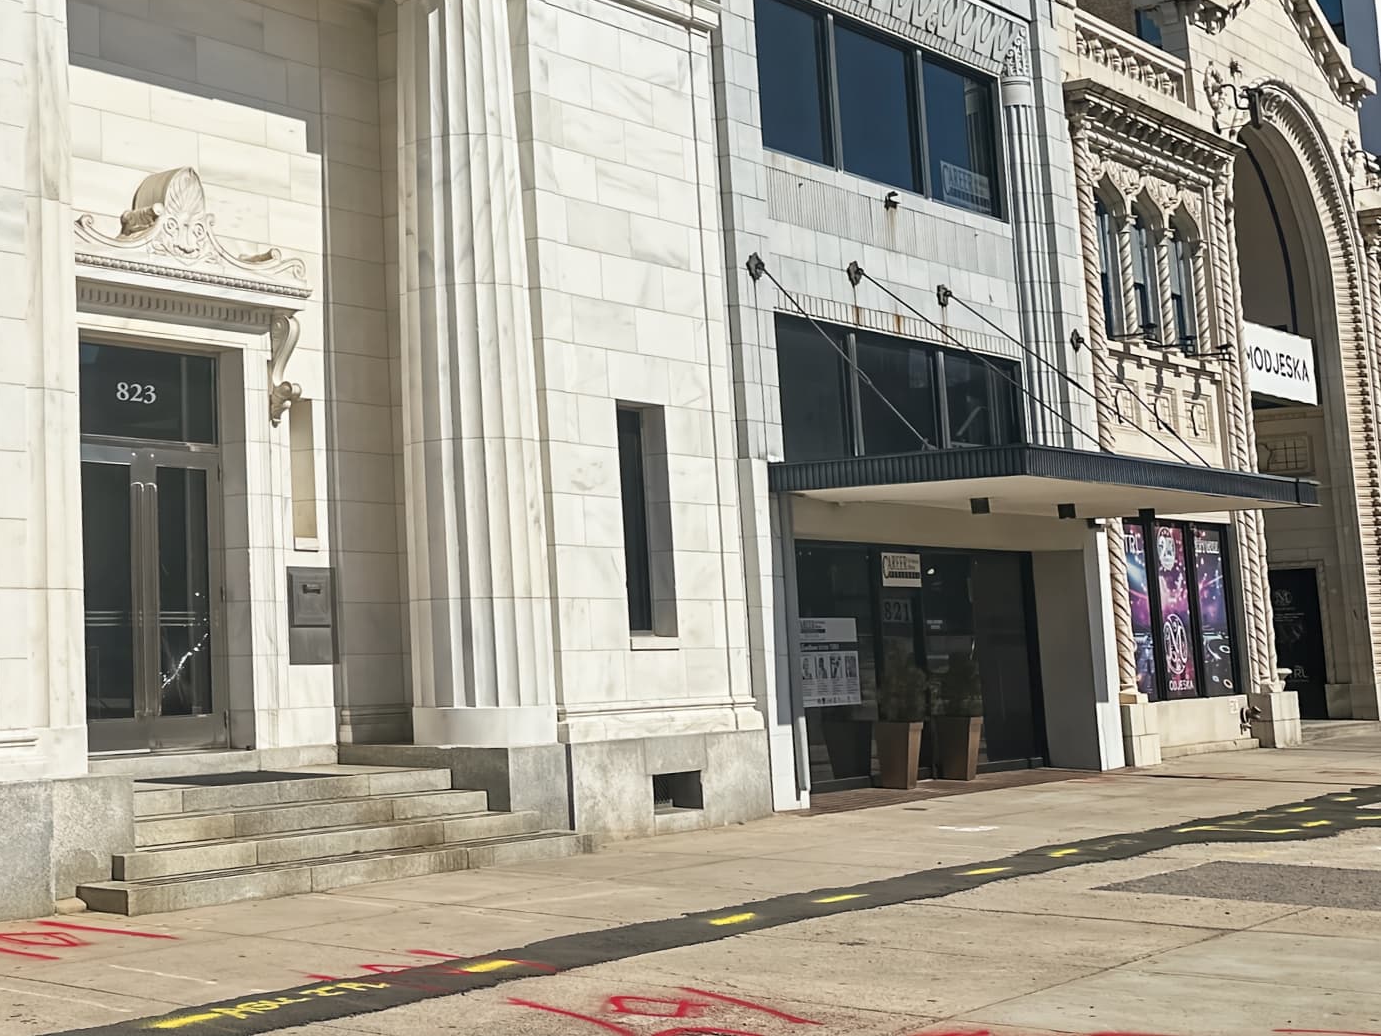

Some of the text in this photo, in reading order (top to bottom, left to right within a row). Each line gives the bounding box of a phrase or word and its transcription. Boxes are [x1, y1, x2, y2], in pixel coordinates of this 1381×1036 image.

[116, 382, 156, 404] 823
[884, 601, 911, 622] 821
[1168, 680, 1195, 692] ODJESKA
